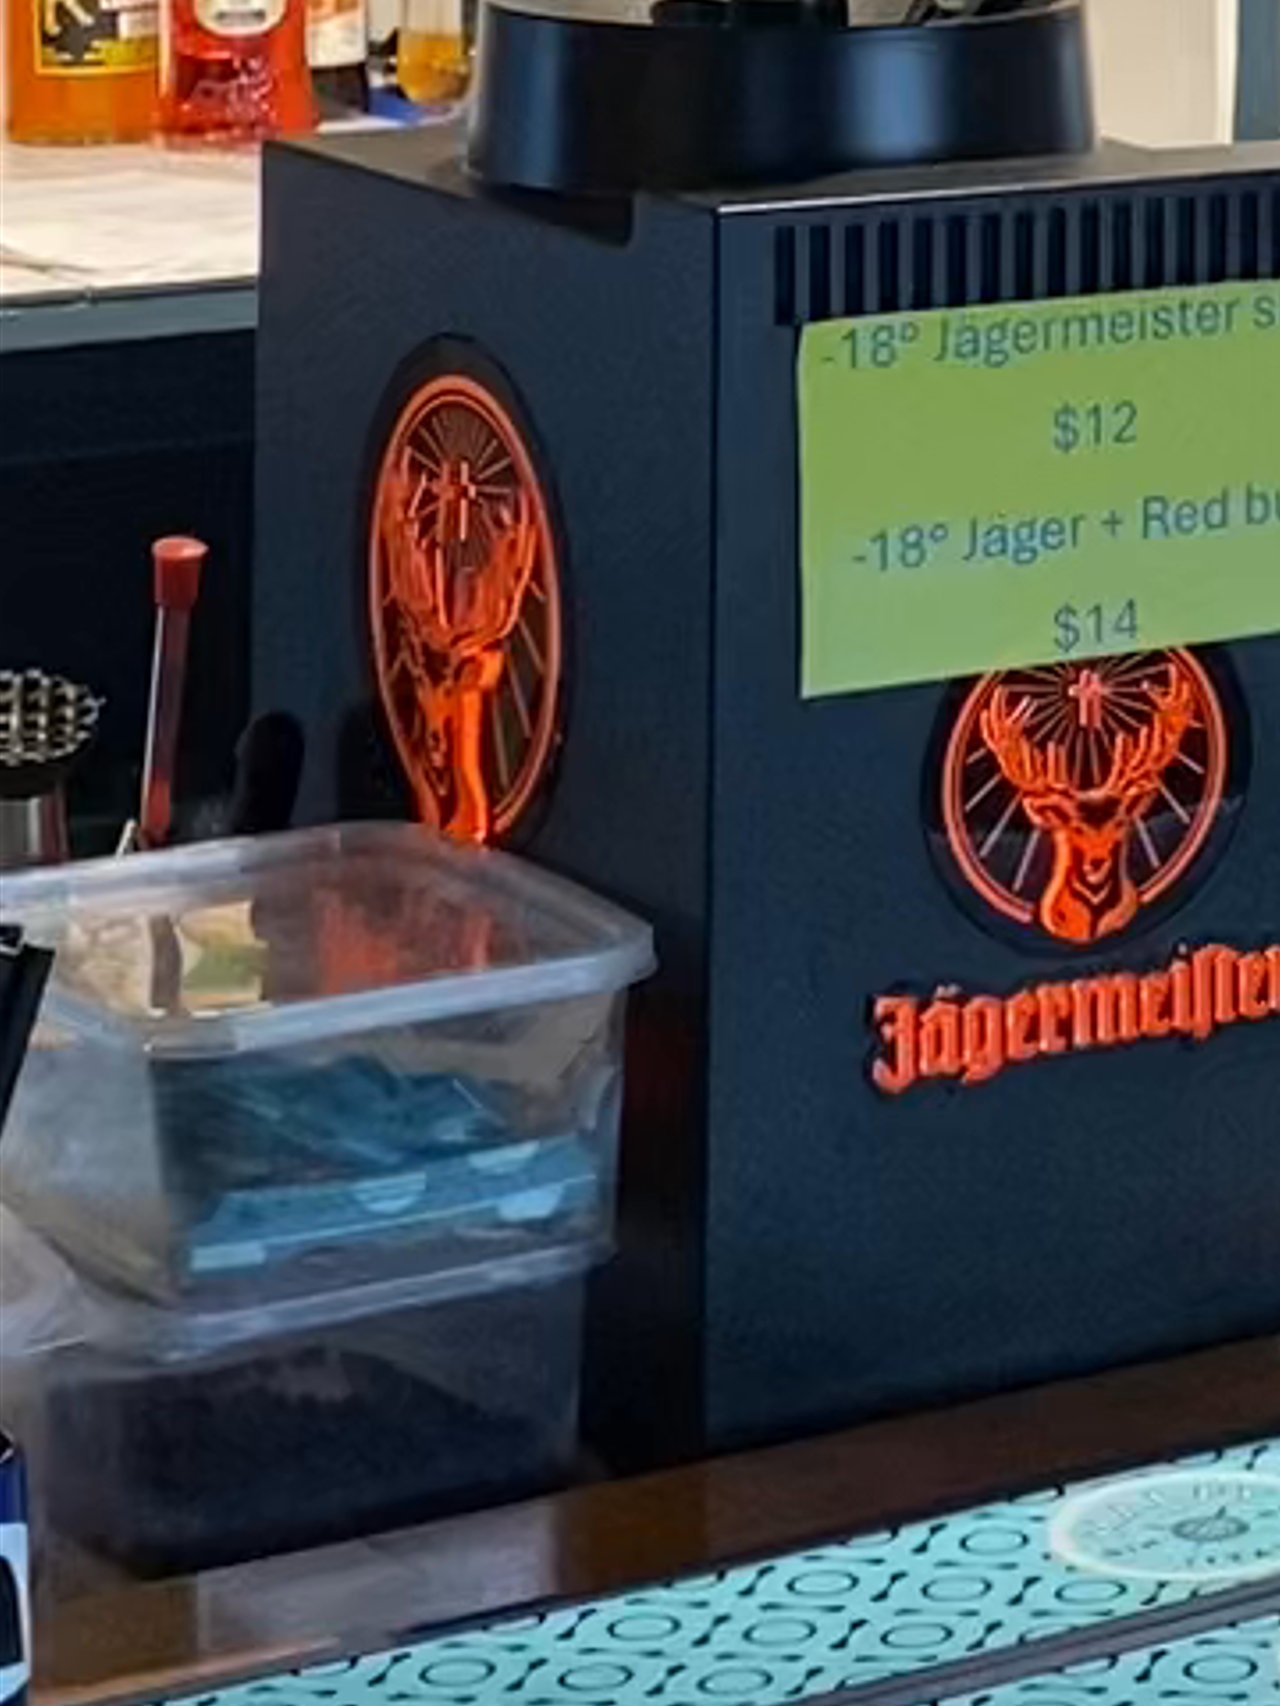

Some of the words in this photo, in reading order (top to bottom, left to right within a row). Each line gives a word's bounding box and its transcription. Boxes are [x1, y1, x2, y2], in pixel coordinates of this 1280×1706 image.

[1051, 400, 1138, 453] $12
[1101, 509, 1124, 535] +
[1141, 487, 1230, 539] Red
[1051, 599, 1138, 652] $14
